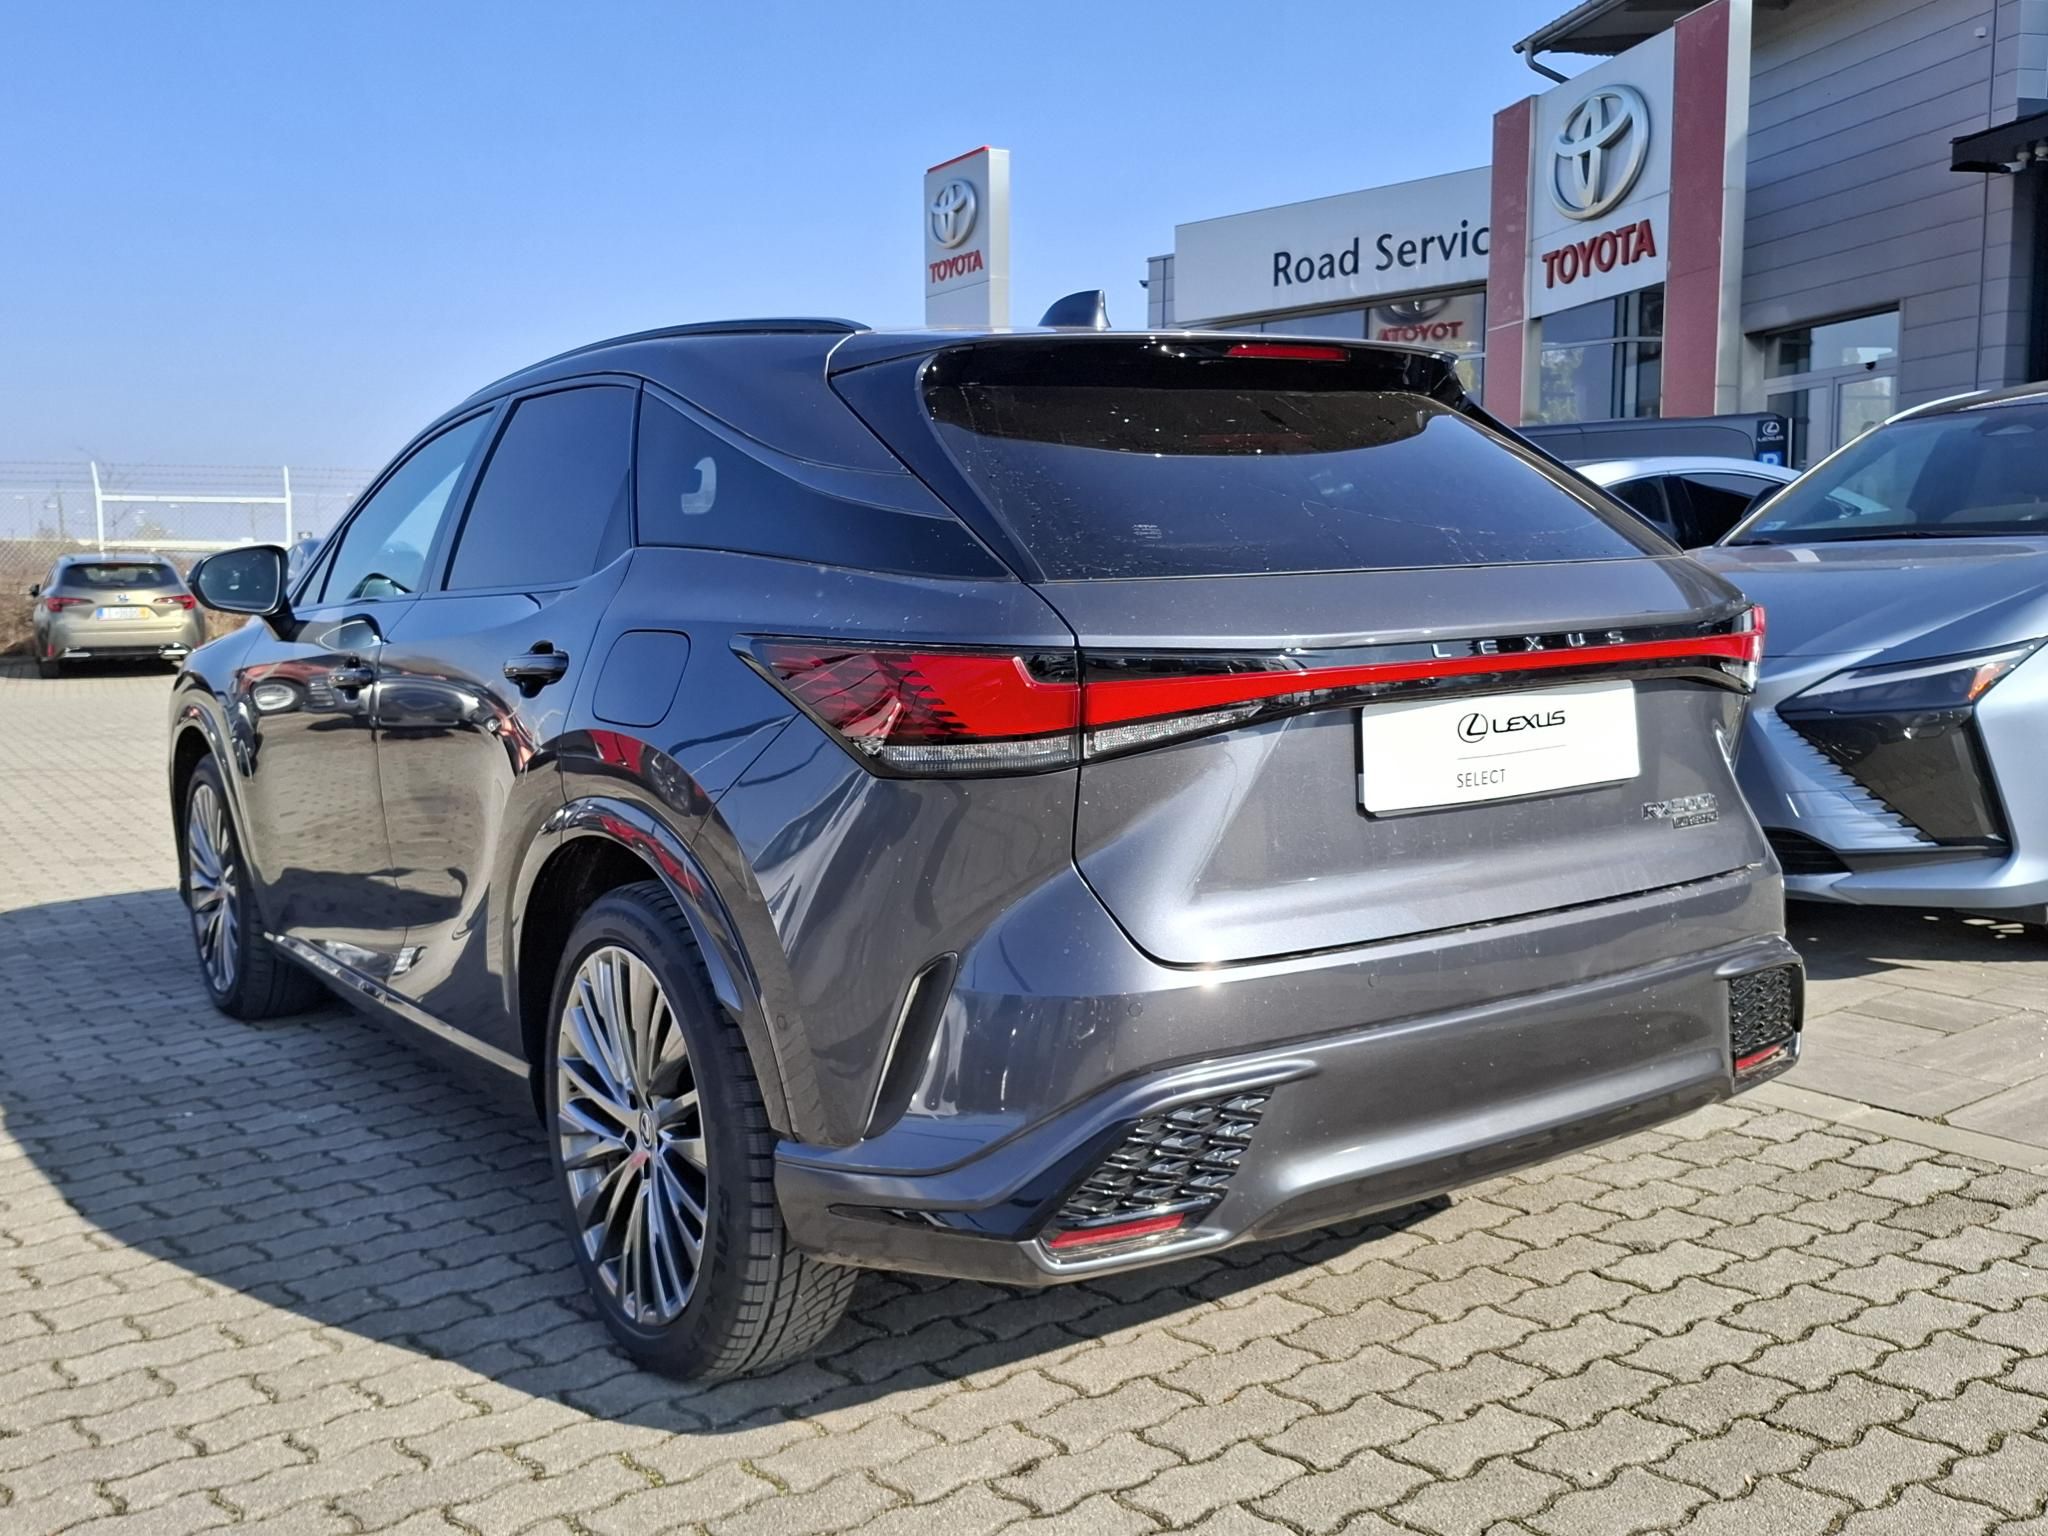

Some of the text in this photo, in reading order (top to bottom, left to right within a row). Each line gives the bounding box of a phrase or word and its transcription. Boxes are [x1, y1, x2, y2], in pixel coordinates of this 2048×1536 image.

[929, 249, 983, 284] TOYOTA
[1273, 219, 1489, 287] Road Servic
[1541, 218, 1656, 289] TOYOTA
[1431, 631, 1625, 658] LEXUS
[1493, 710, 1566, 733] LEXUS
[1457, 769, 1506, 788] SELECT
